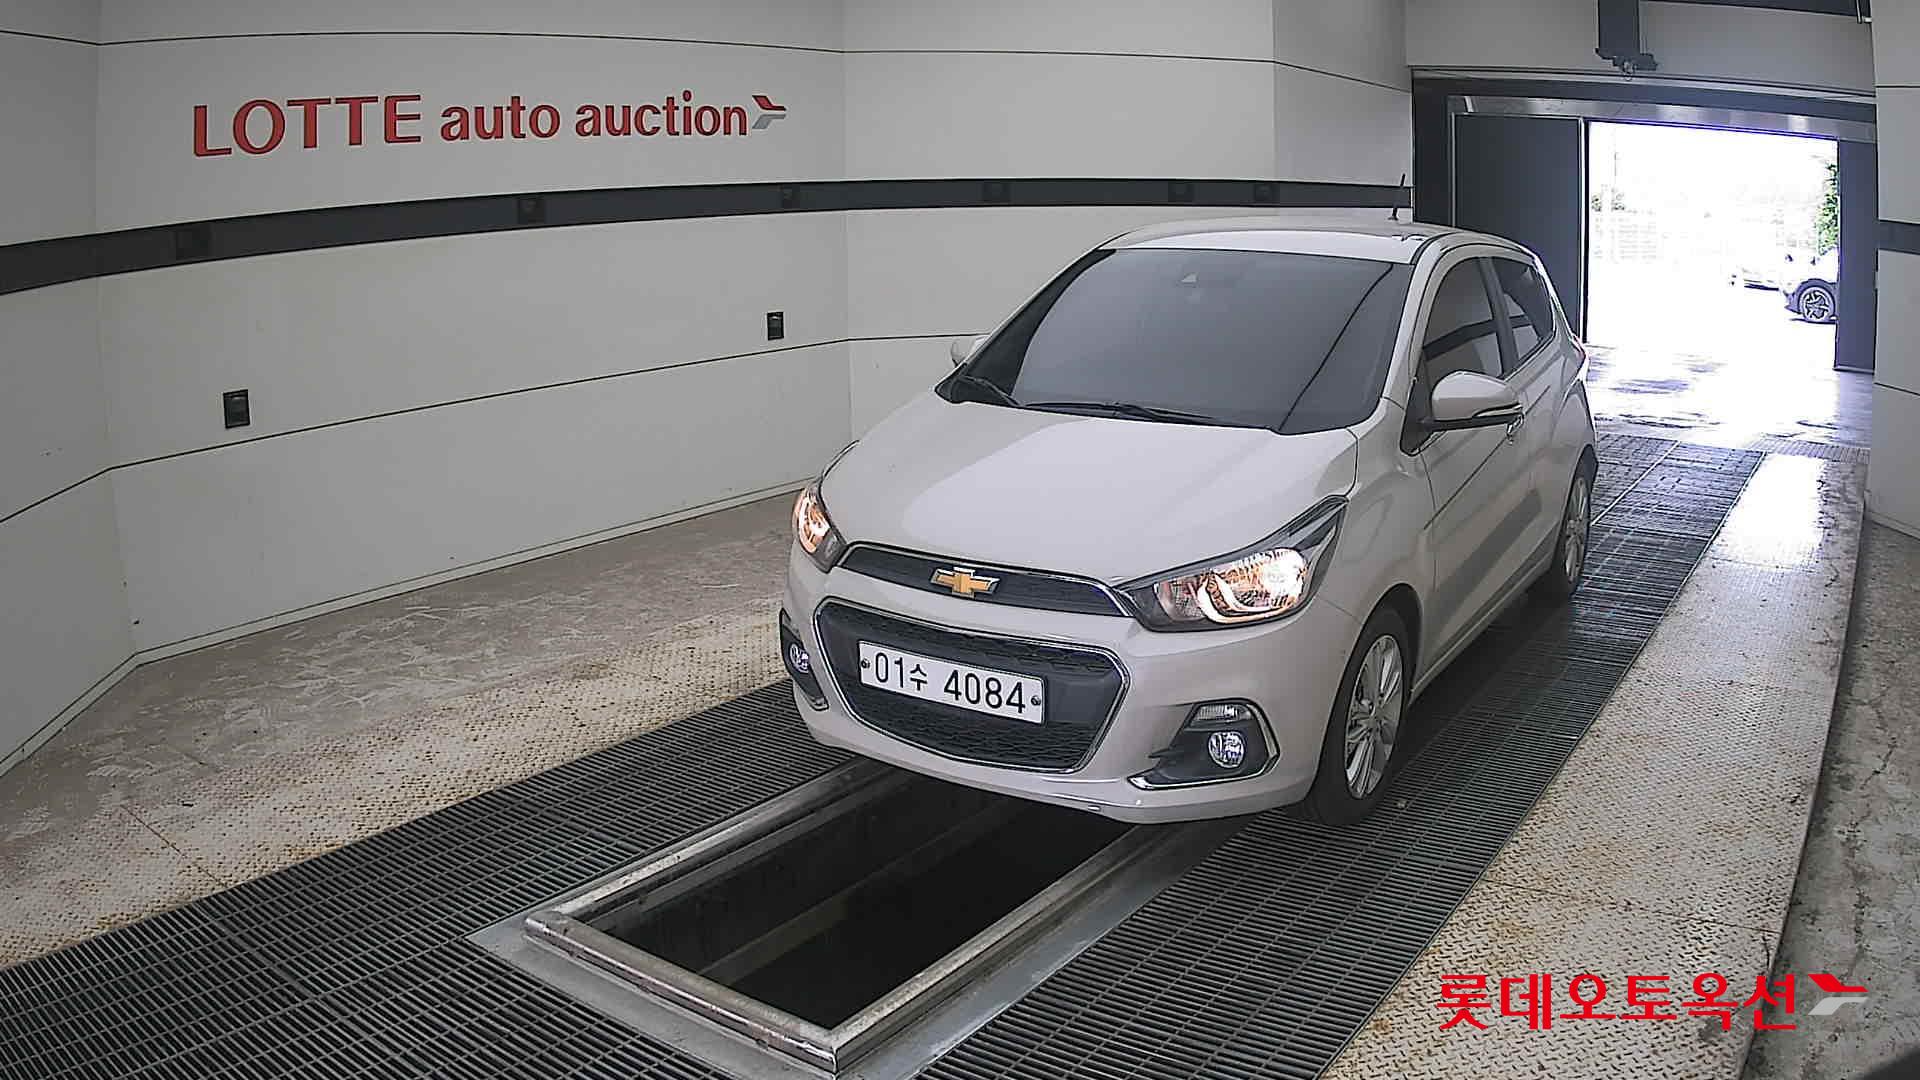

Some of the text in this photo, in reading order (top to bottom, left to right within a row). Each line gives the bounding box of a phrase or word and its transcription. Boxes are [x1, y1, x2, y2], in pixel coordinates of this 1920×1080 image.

[193, 90, 749, 157] LOTTE auto auction
[875, 652, 1026, 714] 01수 4084
